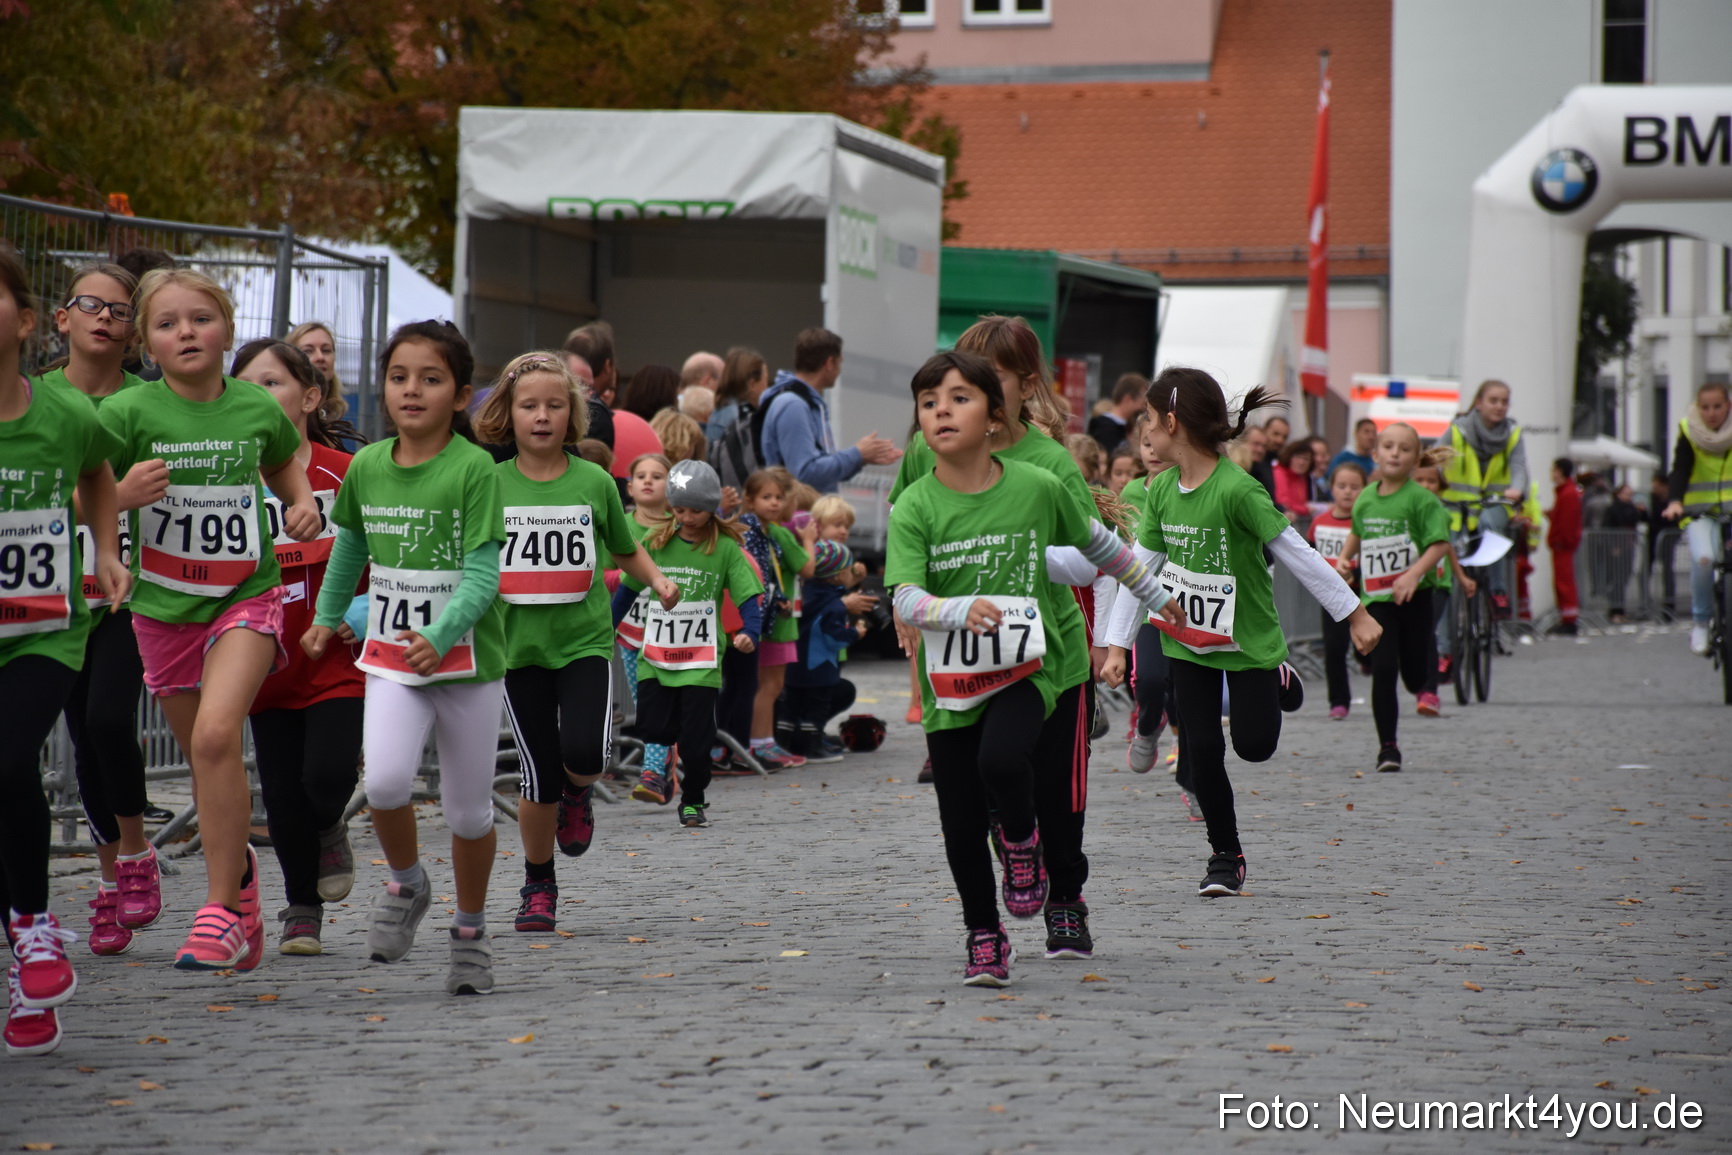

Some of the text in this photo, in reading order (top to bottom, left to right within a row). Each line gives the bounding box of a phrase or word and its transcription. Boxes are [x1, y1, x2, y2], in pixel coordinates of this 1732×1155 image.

[151, 439, 233, 453] Neumarkter
[183, 498, 238, 509] Neumarkt
[152, 507, 247, 554] 7199
[527, 516, 577, 526] Neumarkt
[505, 530, 586, 567] 7406
[0, 543, 55, 590] 93
[182, 563, 208, 580] Lili
[1365, 547, 1411, 576] 7127
[371, 576, 453, 594] PARTL Neumarkt
[668, 608, 703, 617] Neumarkt
[652, 618, 709, 645] 7174
[663, 650, 694, 661] Emilia
[943, 623, 1031, 667] 7017
[953, 668, 1013, 695] Melissa
